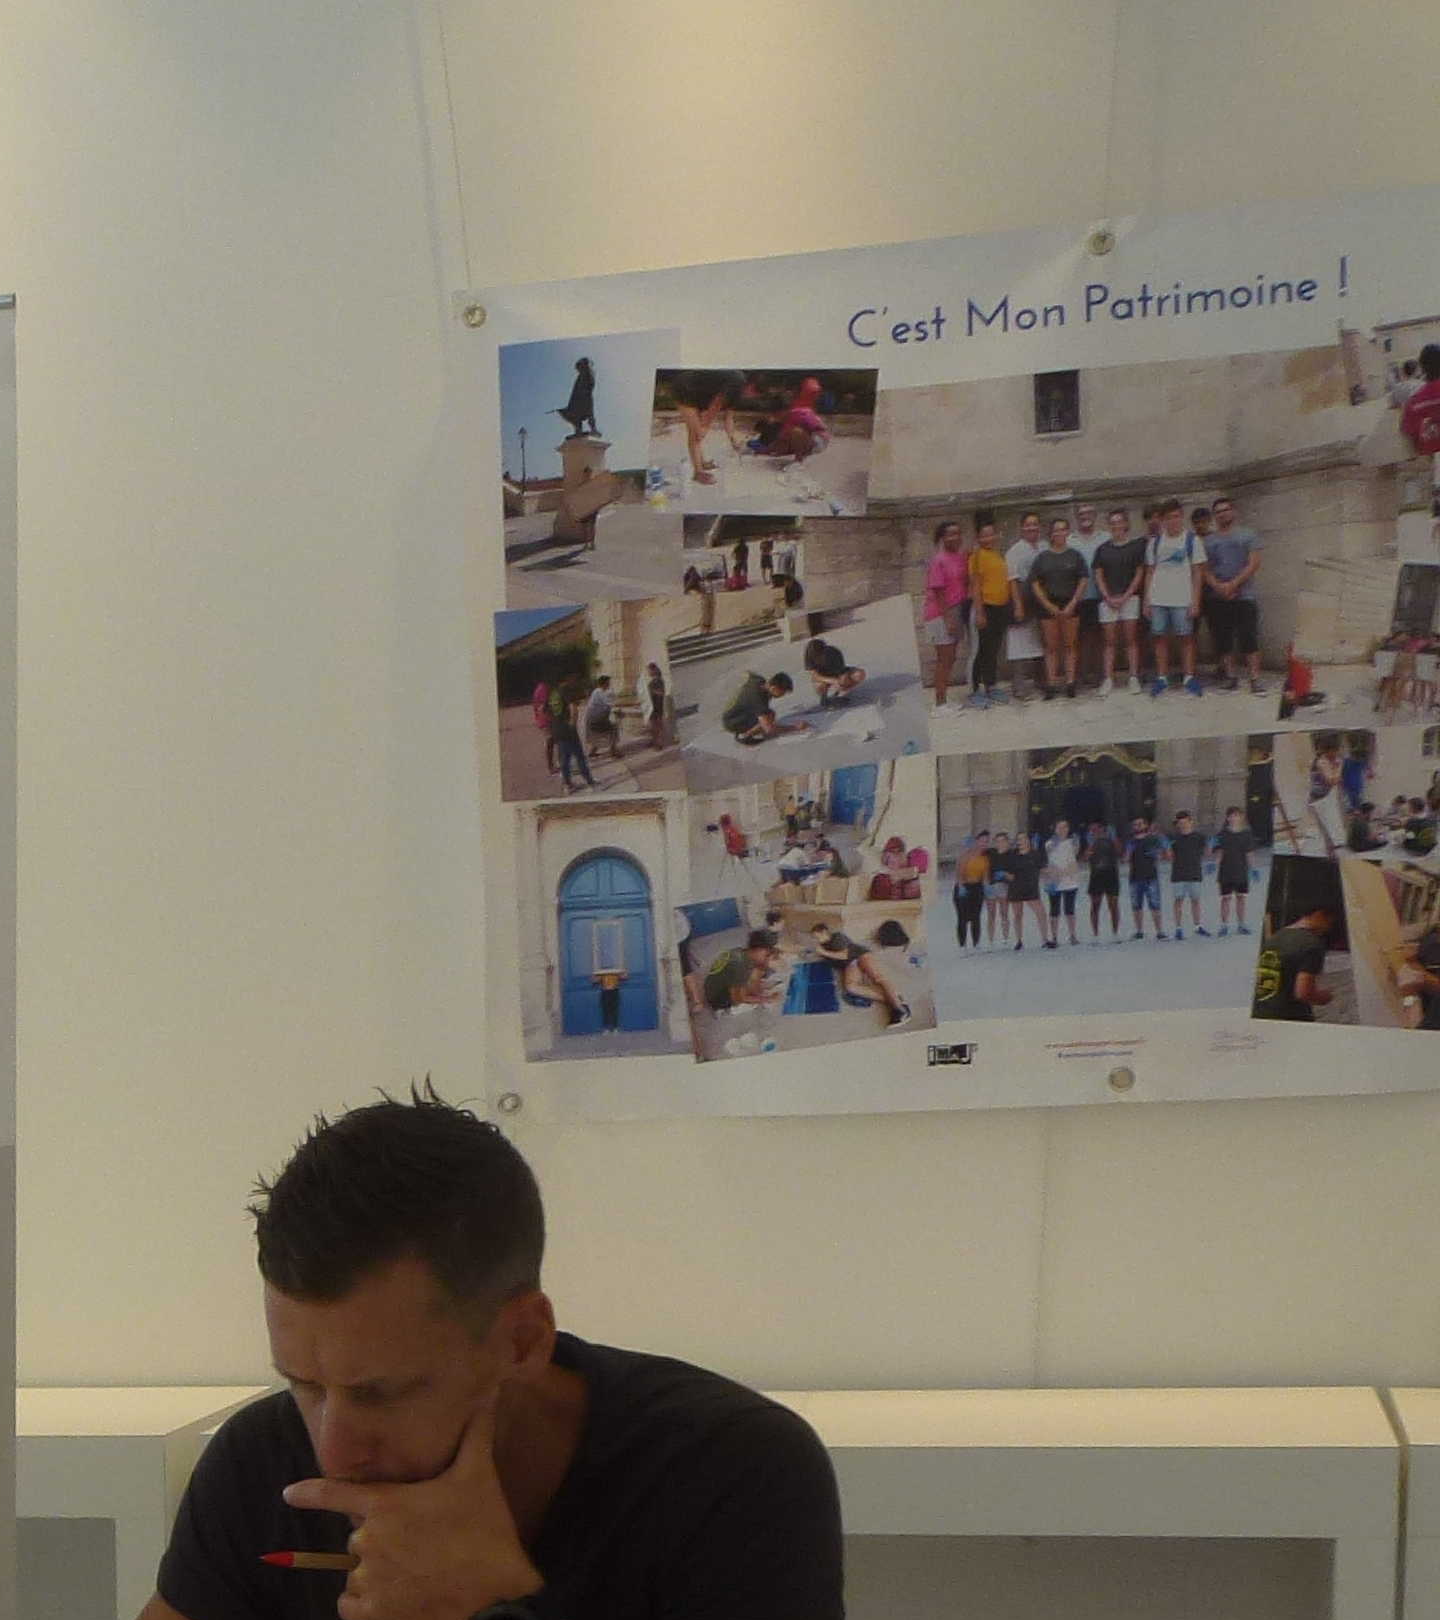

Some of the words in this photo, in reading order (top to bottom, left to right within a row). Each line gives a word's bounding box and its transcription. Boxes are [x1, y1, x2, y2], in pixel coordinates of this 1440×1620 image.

[847, 302, 945, 347] C'est
[966, 294, 1065, 337] Mon
[1085, 274, 1319, 322] Patrimoine
[1337, 255, 1350, 298] !
